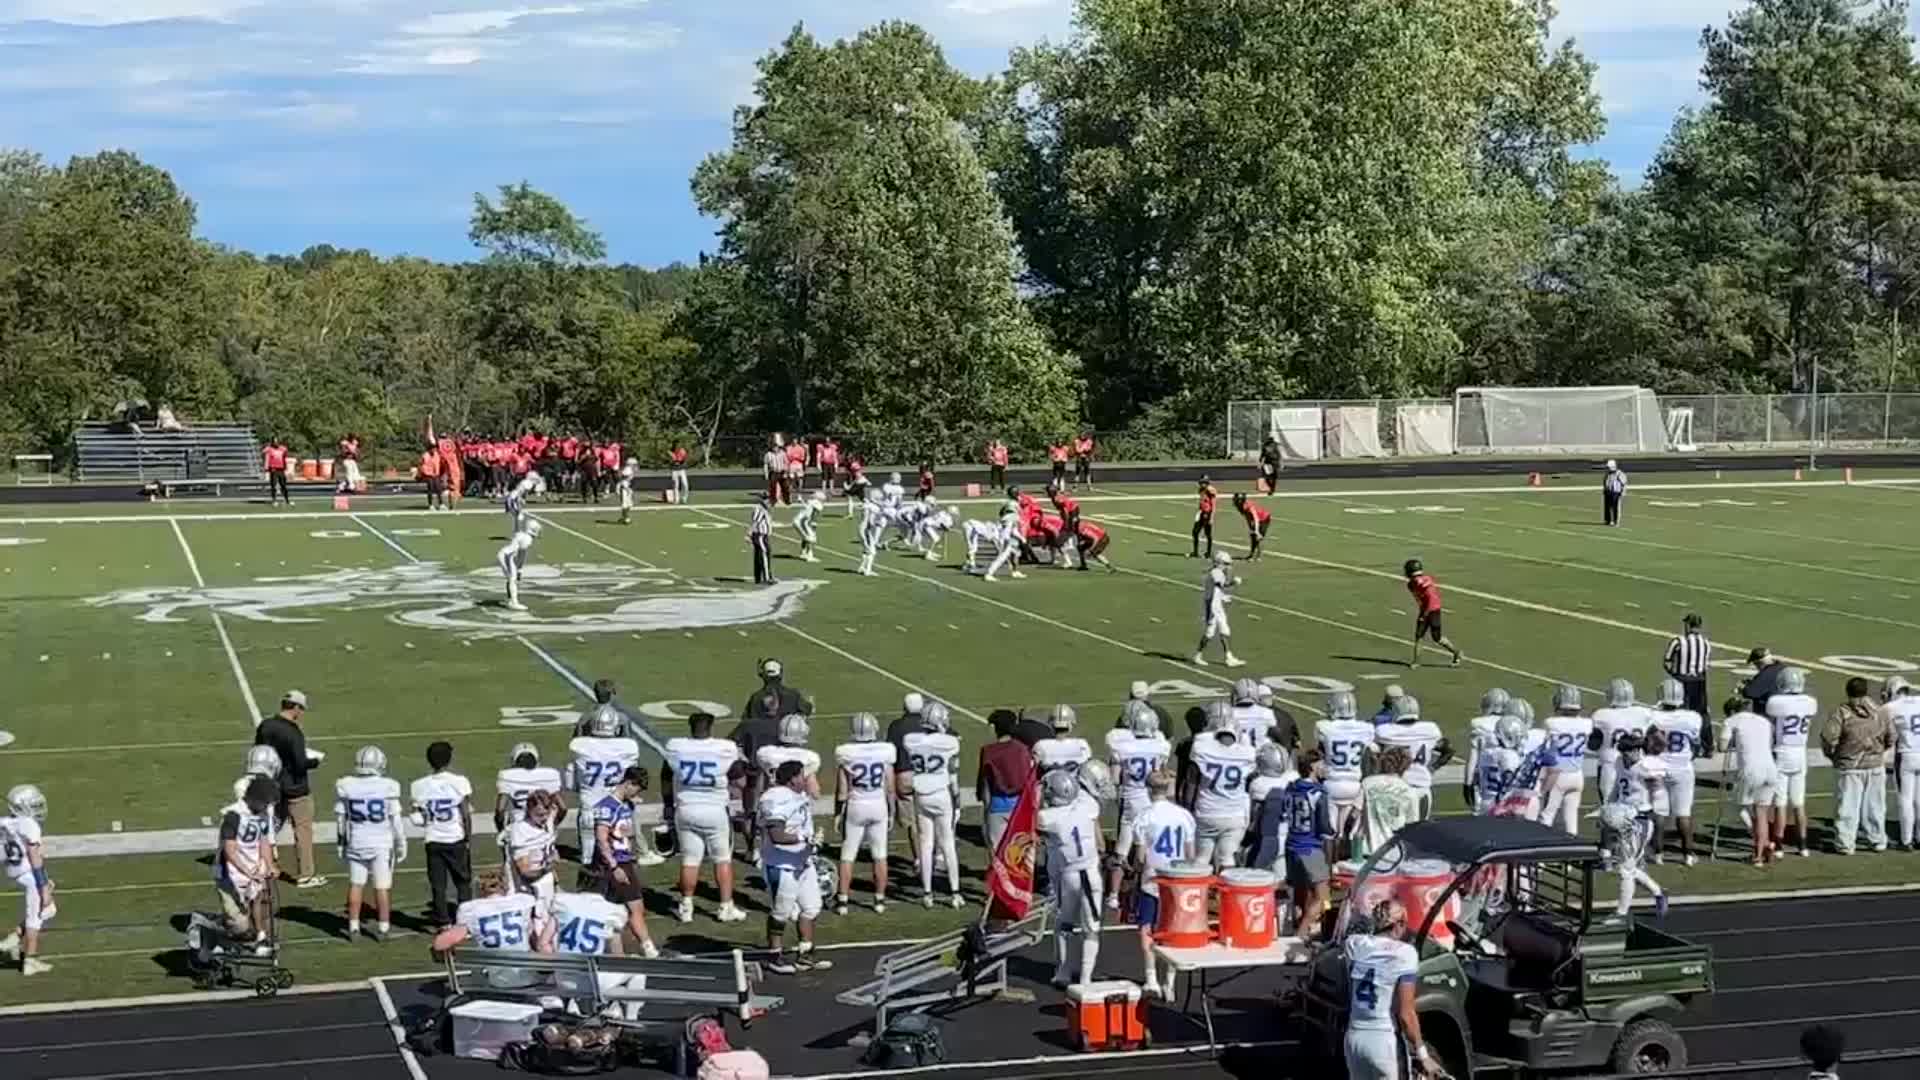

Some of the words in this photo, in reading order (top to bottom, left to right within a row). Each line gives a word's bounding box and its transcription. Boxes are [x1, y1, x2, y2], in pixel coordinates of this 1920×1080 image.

[1331, 740, 1363, 766] 53
[1558, 733, 1586, 758] 22
[585, 761, 622, 787] 72
[679, 761, 718, 788] 75
[852, 762, 885, 788] 28
[1204, 763, 1242, 790] 79
[348, 798, 386, 823] 58
[1072, 826, 1083, 857] 1
[1153, 825, 1184, 858] 41
[1180, 888, 1201, 913] G
[1247, 896, 1265, 920] G
[478, 911, 523, 950] 55
[558, 917, 606, 954] 45
[1354, 967, 1379, 1011] 4
